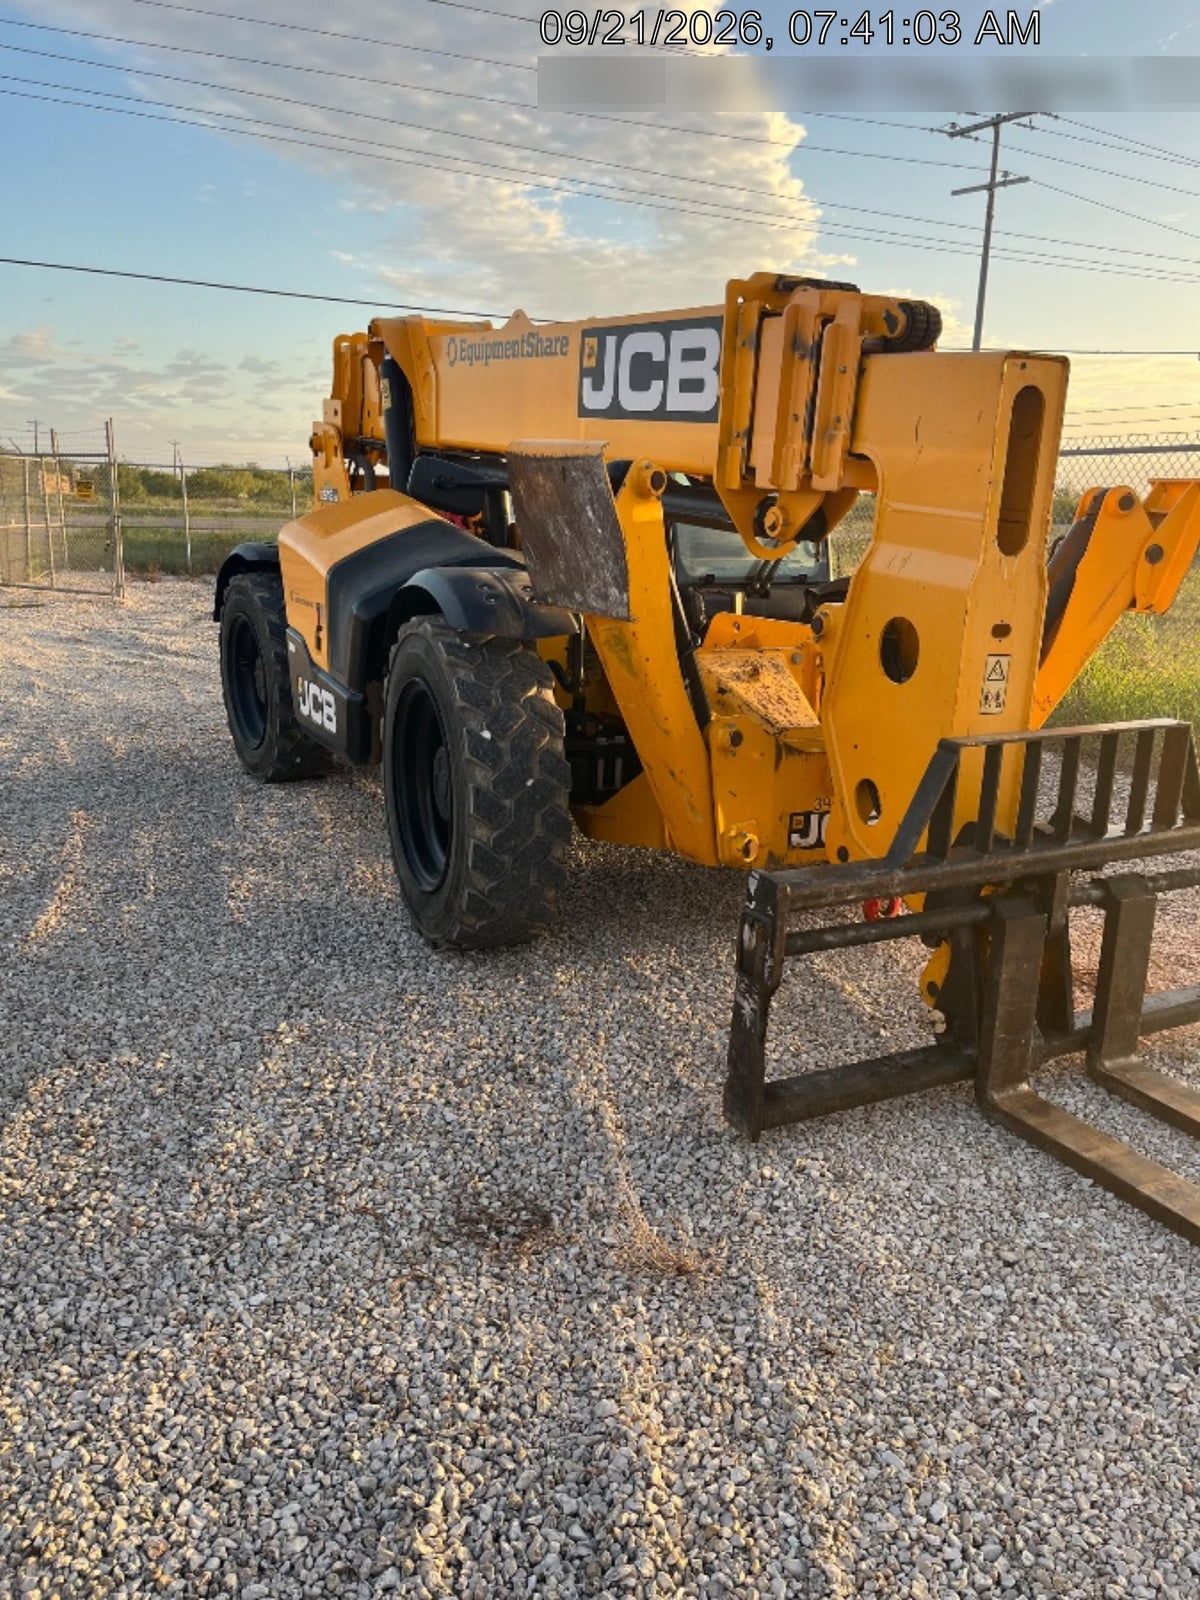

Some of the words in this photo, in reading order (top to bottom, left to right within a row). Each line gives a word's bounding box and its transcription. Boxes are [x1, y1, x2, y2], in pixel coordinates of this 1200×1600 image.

[458, 332, 570, 367] EquipmentShare
[582, 327, 720, 412] JCB
[299, 680, 337, 734] JCB
